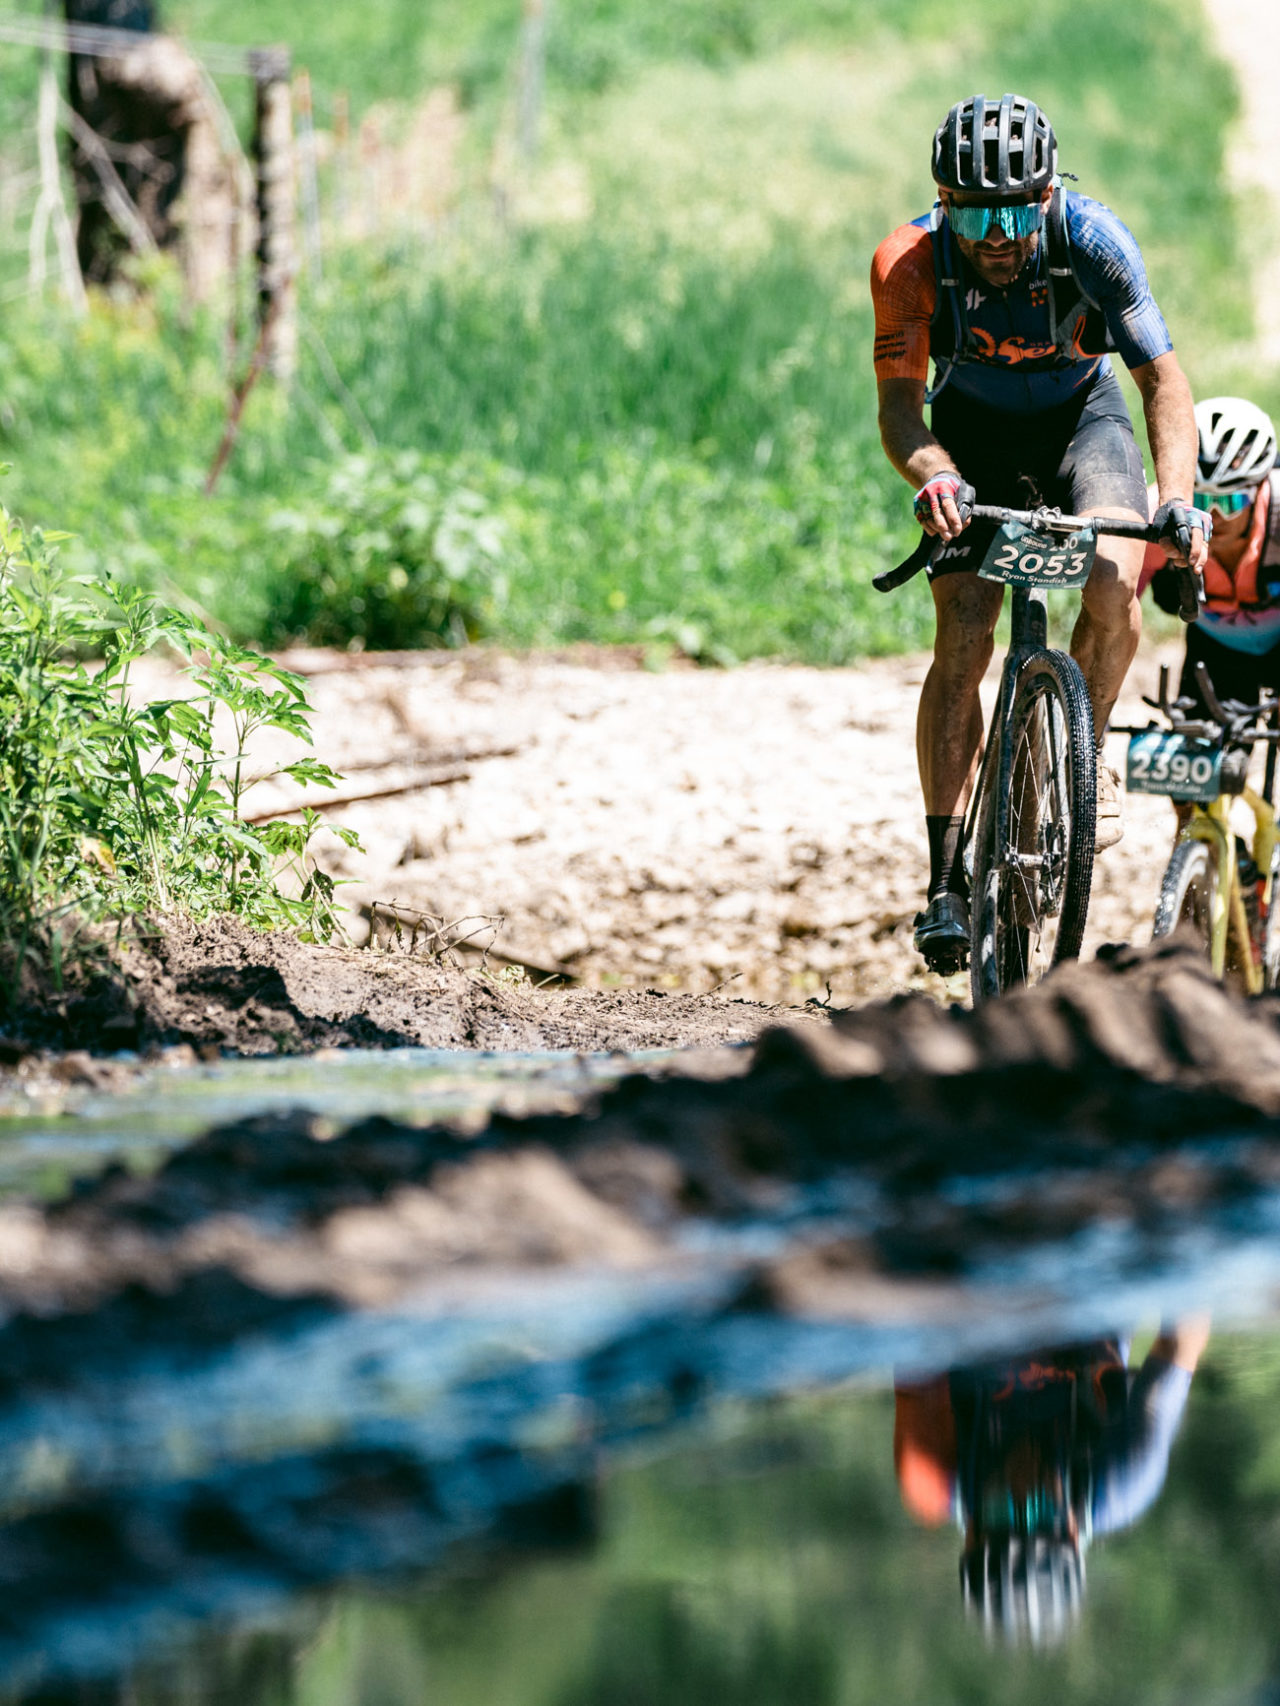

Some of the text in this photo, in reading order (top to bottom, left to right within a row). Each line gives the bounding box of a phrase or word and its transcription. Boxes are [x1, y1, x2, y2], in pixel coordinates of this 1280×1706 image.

[993, 544, 1088, 576] 2053
[1001, 571, 1026, 580] Ryan
[1027, 575, 1068, 584] Standish
[1131, 750, 1212, 785] 2390
